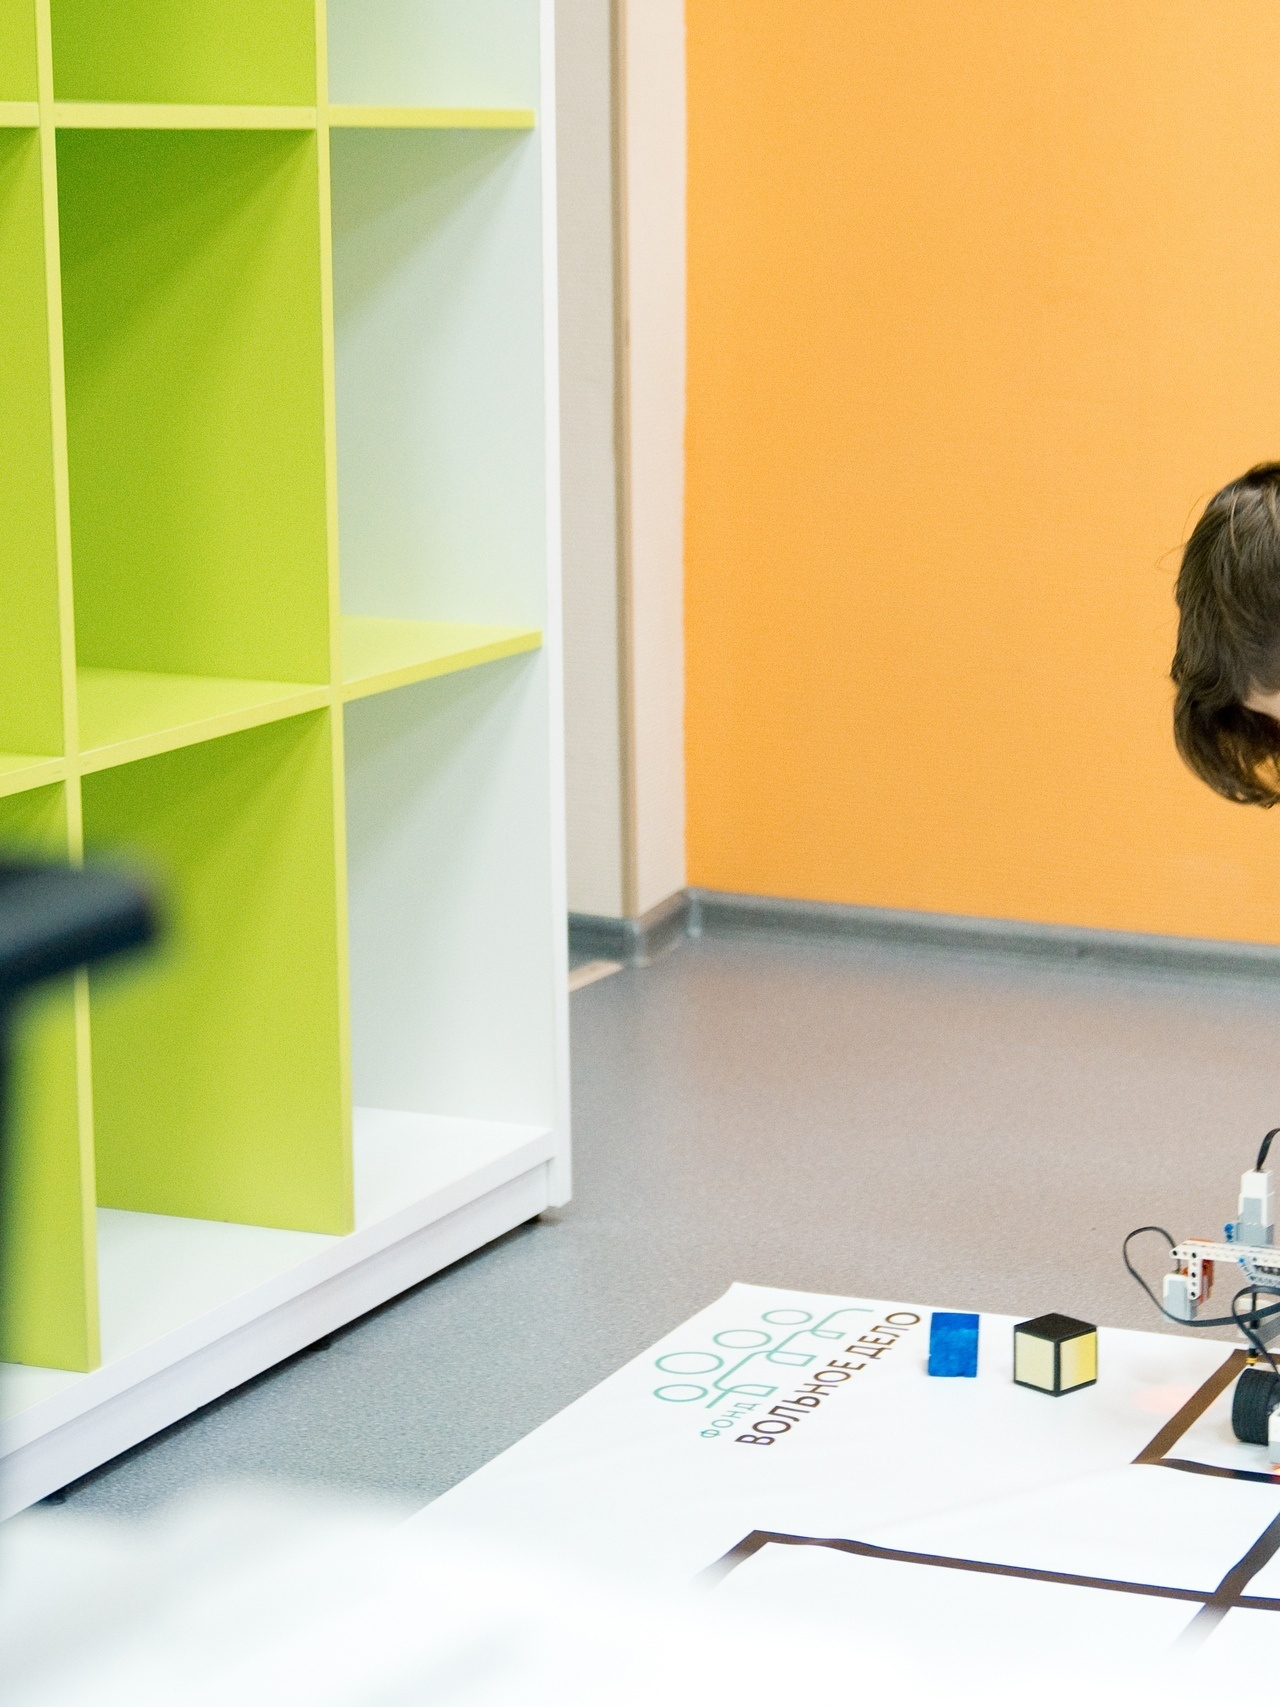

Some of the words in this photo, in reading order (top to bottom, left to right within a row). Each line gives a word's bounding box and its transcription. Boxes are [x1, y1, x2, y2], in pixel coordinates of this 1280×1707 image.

[700, 1402, 762, 1438] ФОНД
[734, 1359, 867, 1446] ВОЛЬНОЕ
[844, 1311, 921, 1360] ДЕЛО
